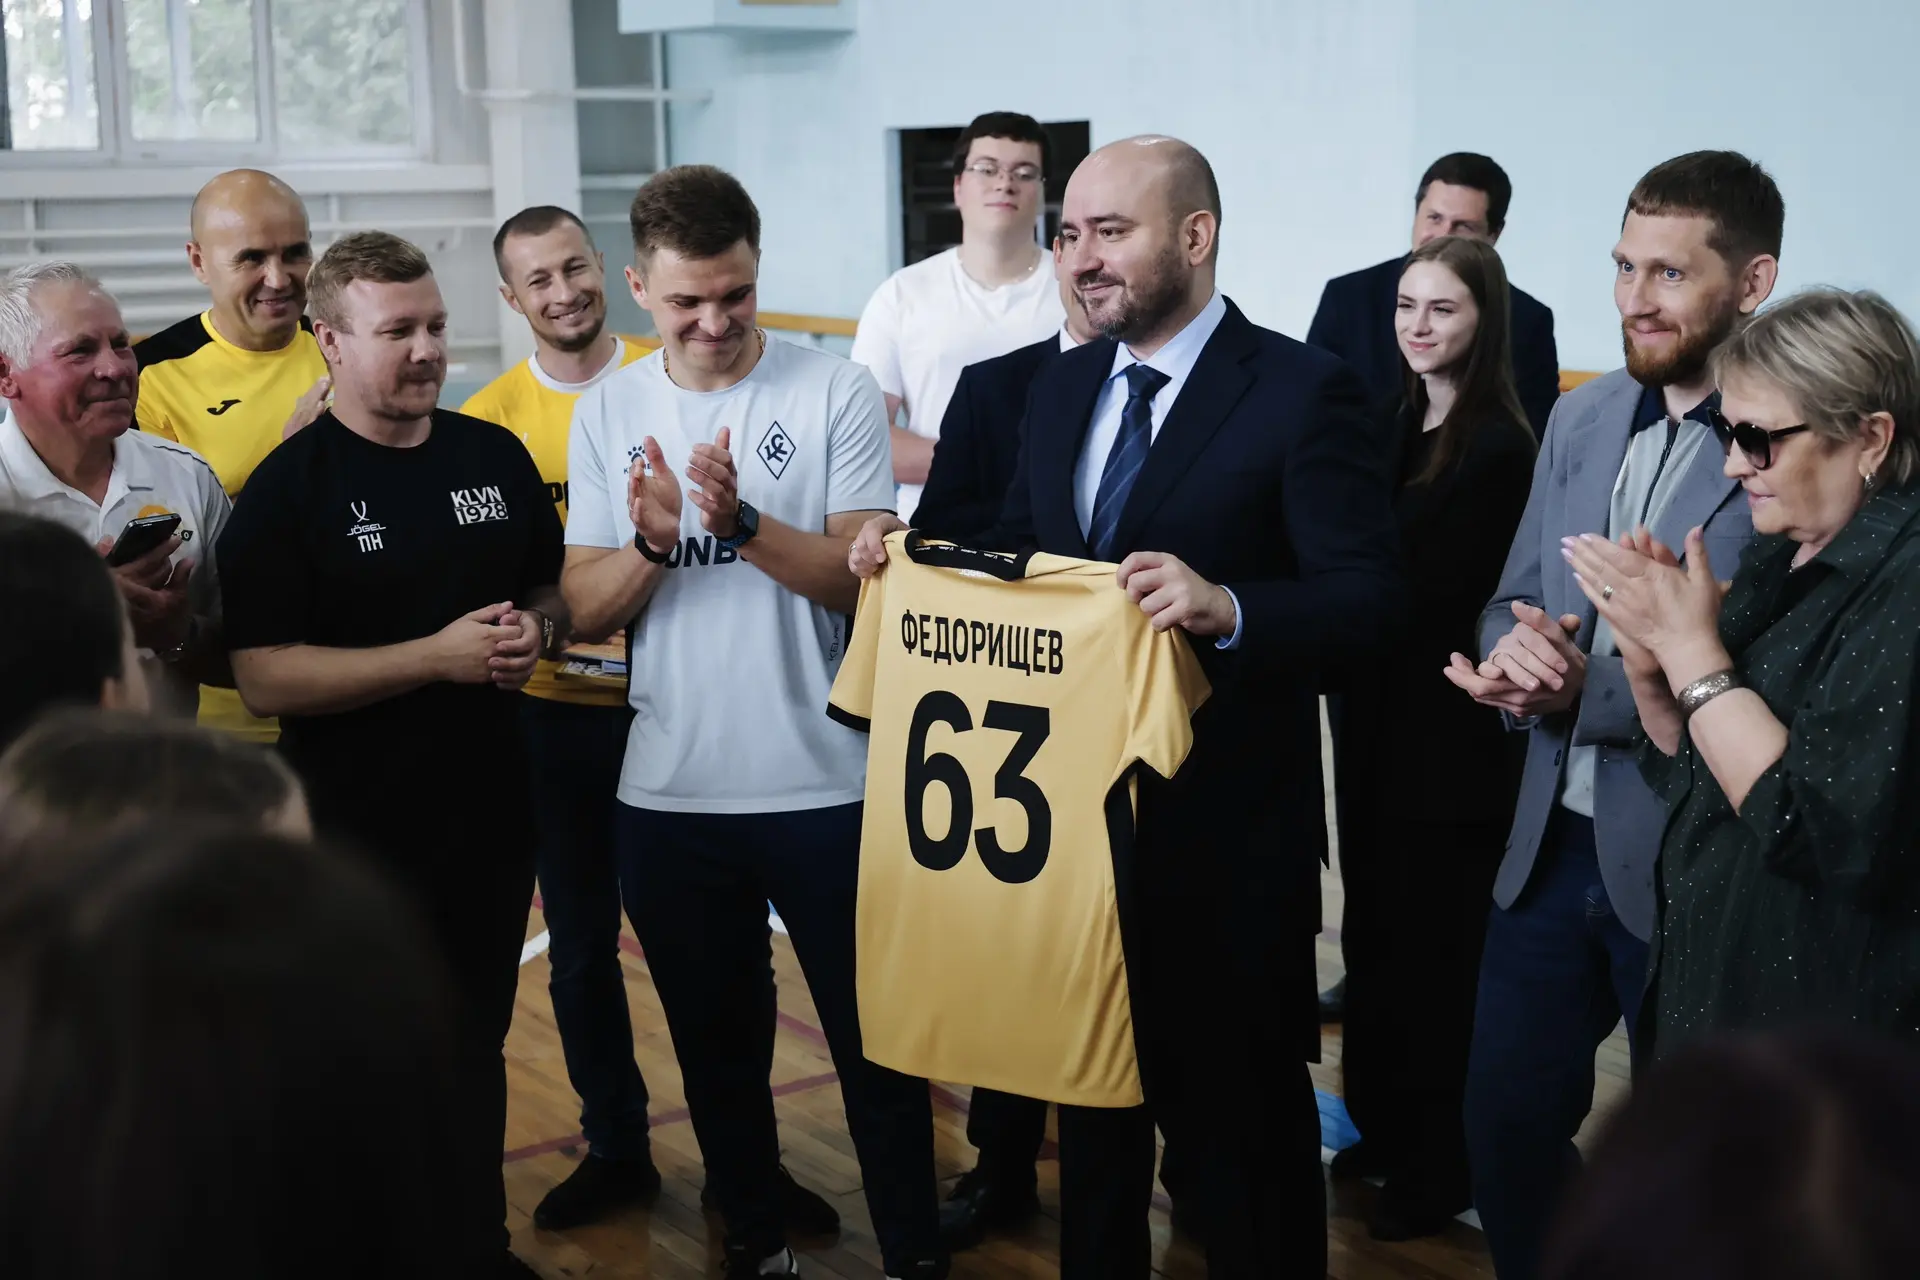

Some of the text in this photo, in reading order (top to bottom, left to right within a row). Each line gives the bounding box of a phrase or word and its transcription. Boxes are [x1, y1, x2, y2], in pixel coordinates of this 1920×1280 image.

[450, 486, 502, 508] KLVN
[454, 502, 509, 525] 1928
[347, 523, 387, 536] JÖGEL
[357, 532, 384, 553] ПН
[901, 608, 1064, 677] ФЕДОРИЩЕВ
[904, 689, 1052, 884] 63
